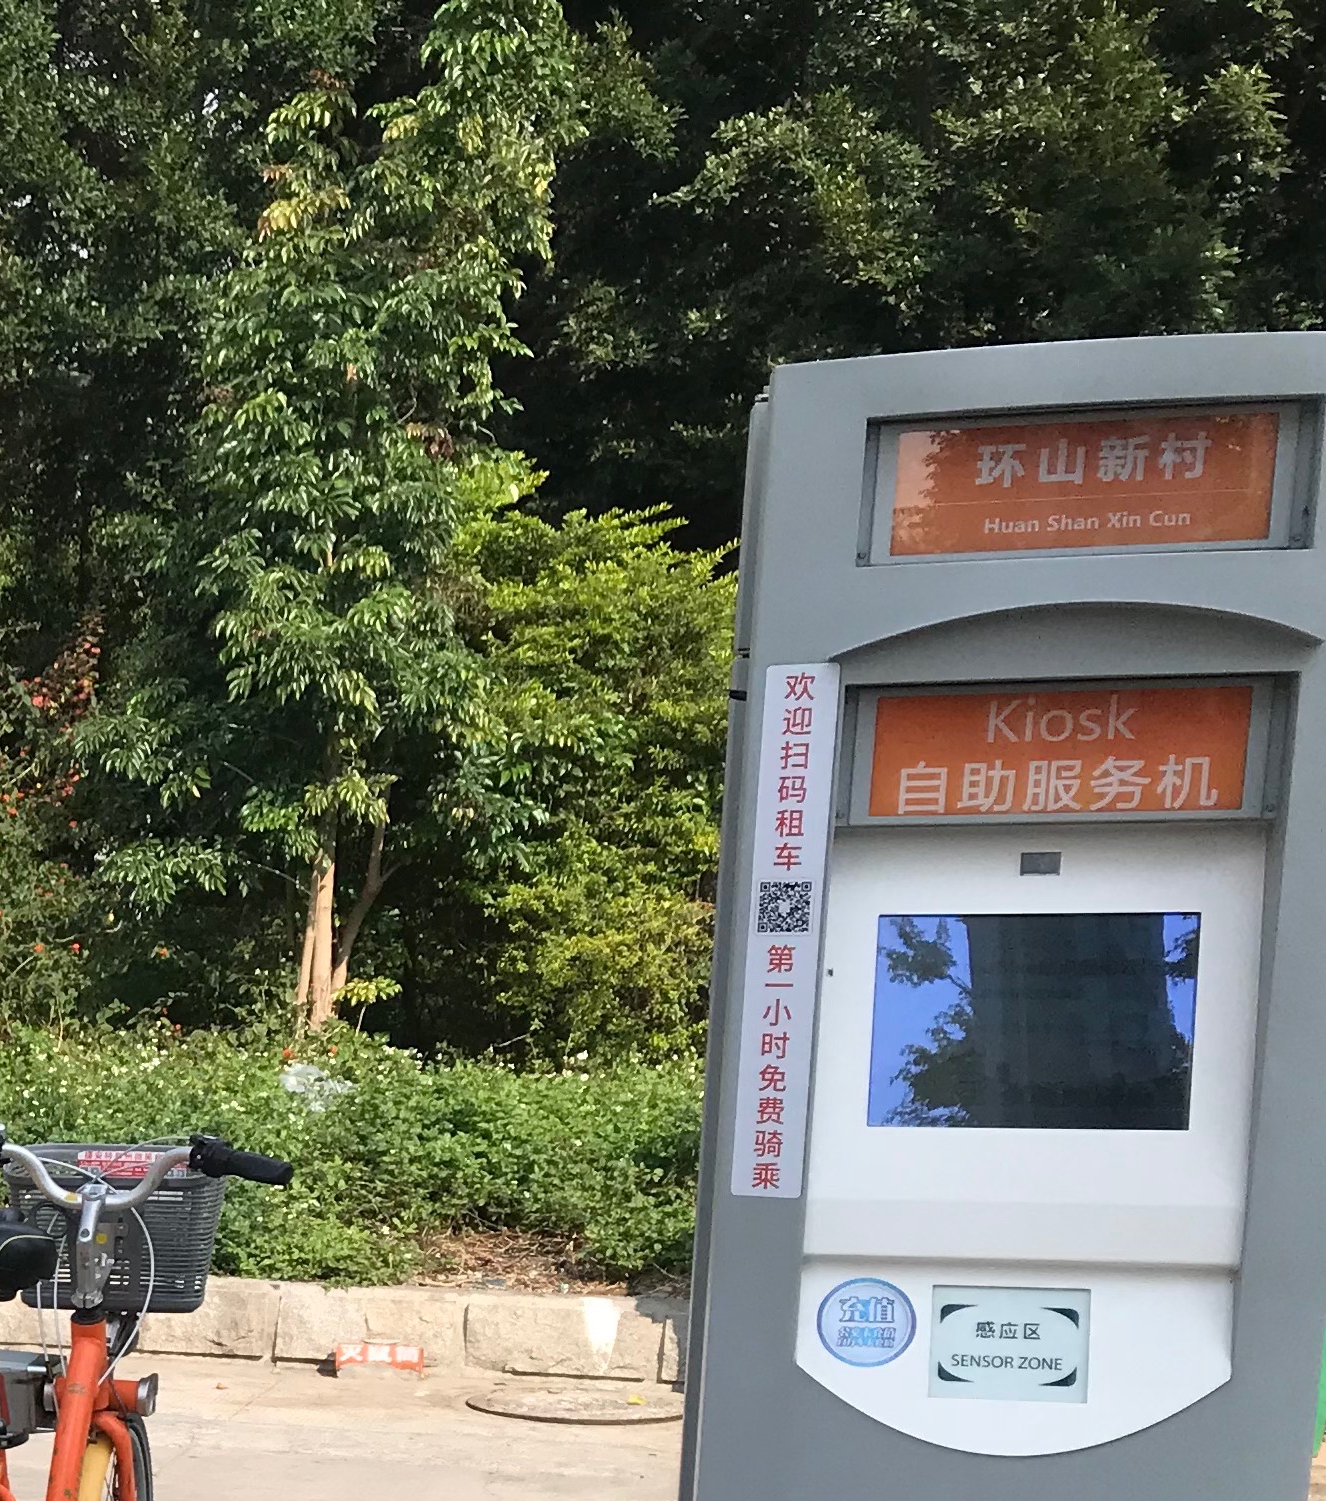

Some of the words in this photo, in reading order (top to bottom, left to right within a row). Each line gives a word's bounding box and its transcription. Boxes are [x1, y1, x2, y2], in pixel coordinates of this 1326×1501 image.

[975, 431, 1213, 488] 环山新村
[984, 517, 1039, 534] Huan
[1047, 514, 1099, 531] Shan
[1107, 511, 1141, 529] Xin
[1150, 511, 1190, 527] Cun
[986, 697, 1136, 744] Kiosk
[773, 672, 816, 872] 欢迎扫码租车
[897, 756, 1218, 815] 自助服务机
[751, 944, 796, 1190] 第一小时免费骑乘
[839, 1296, 895, 1323] 充值
[975, 1320, 1041, 1340] 感应区
[951, 1353, 1014, 1369] SENSOR
[1018, 1356, 1063, 1371] ZONE
